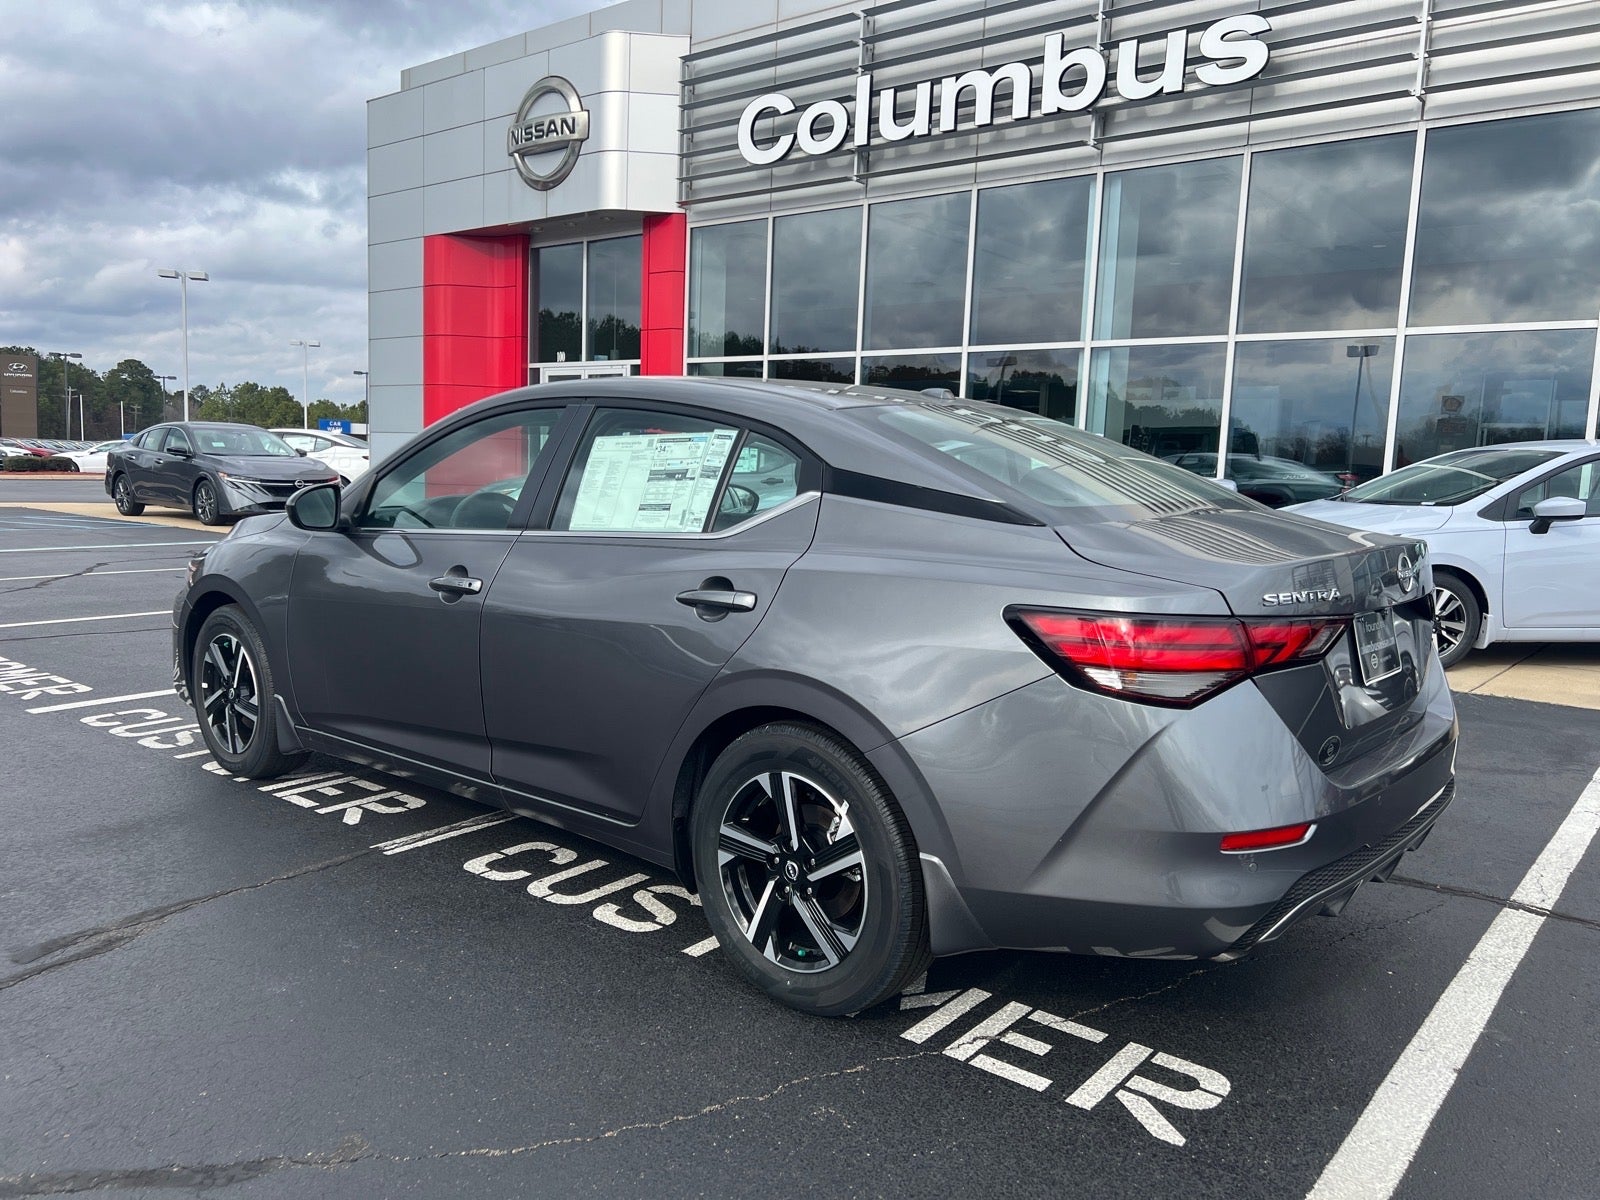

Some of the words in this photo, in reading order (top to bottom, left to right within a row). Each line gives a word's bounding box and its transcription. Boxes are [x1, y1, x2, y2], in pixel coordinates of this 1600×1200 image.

[737, 14, 1272, 166] Columbus
[511, 117, 576, 146] NISSAN
[1262, 588, 1341, 607] SENTRA
